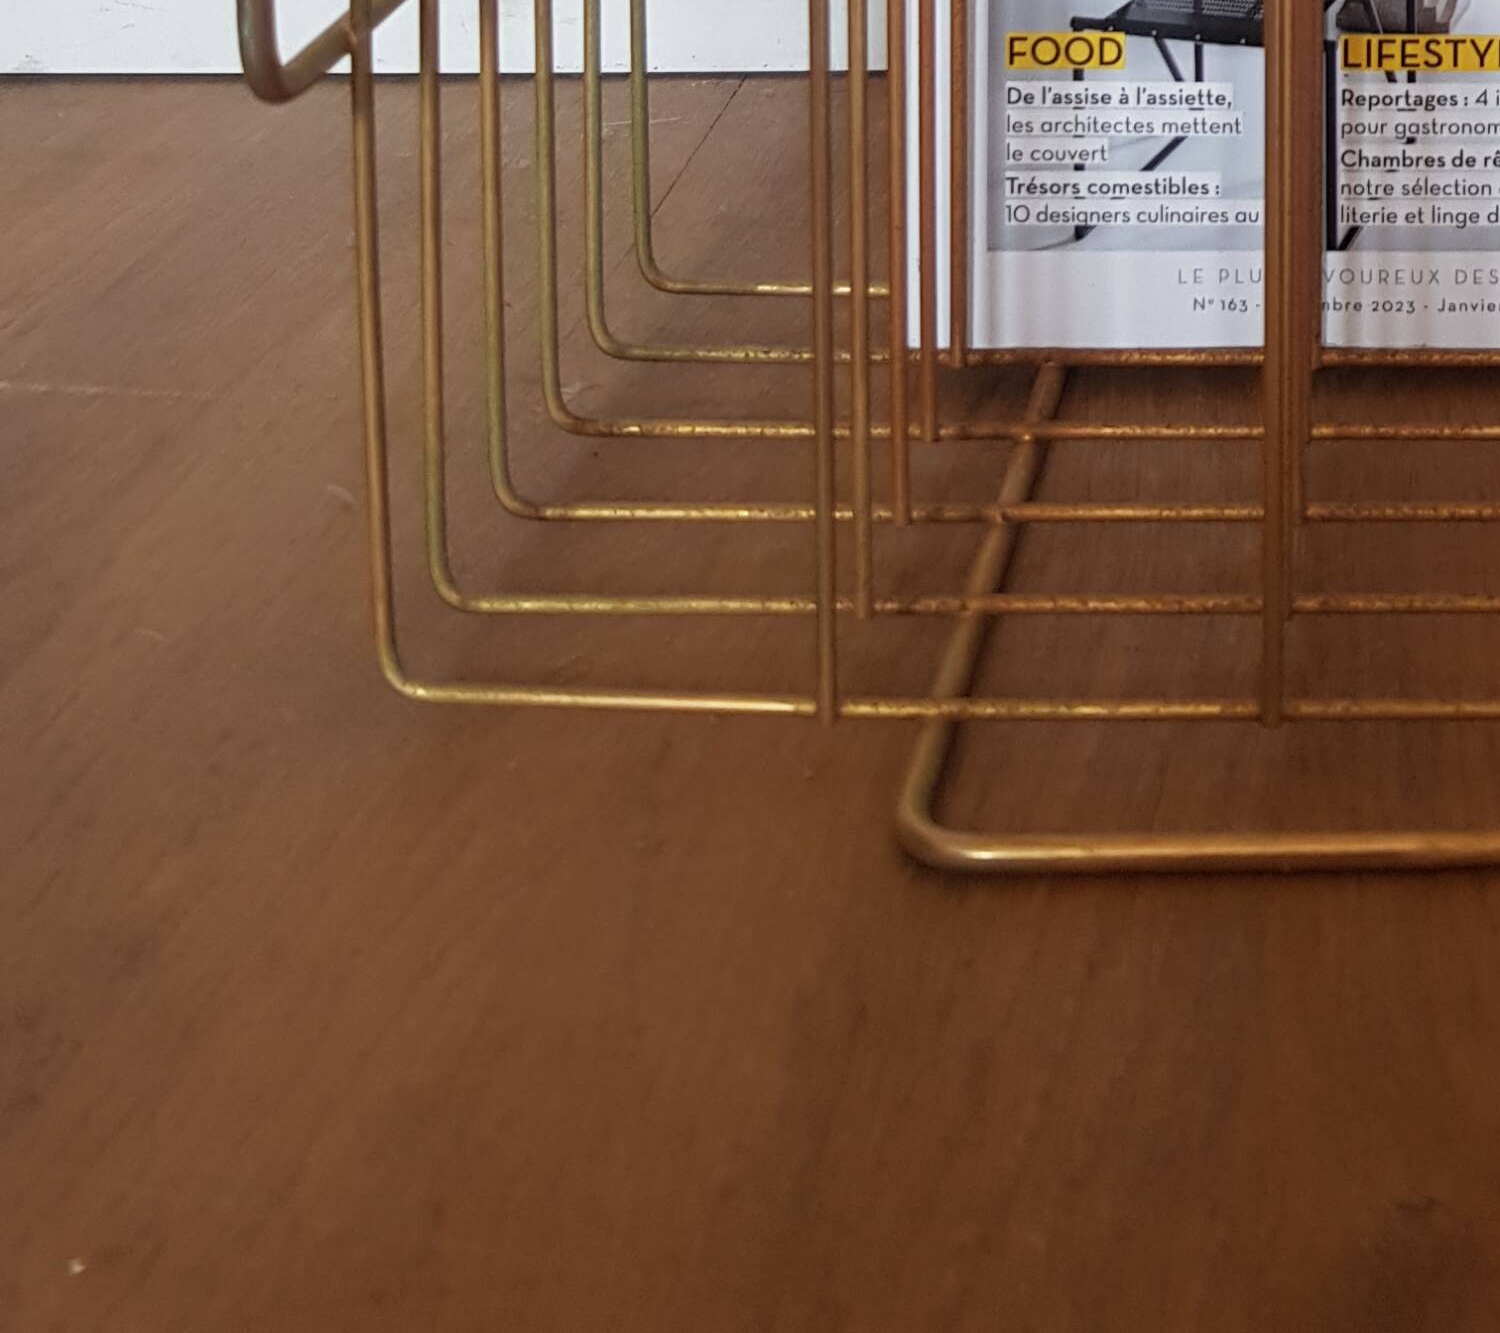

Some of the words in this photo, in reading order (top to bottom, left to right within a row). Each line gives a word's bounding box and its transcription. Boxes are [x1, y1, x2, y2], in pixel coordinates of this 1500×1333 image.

[1009, 36, 1123, 66] FOOD
[1007, 86, 1035, 105] De
[1119, 88, 1130, 105] à
[1341, 89, 1458, 112] Reportages
[1475, 89, 1489, 106] 4
[1007, 113, 1034, 133] les
[1041, 113, 1155, 134] architectes
[1162, 117, 1242, 134] mettent
[1341, 121, 1388, 139] pour
[1006, 143, 1023, 162] le
[1031, 144, 1107, 162] couvert
[1340, 149, 1446, 169] Chambres
[1451, 149, 1476, 169] de
[1005, 176, 1081, 195] Trésors
[1087, 176, 1210, 195] comestibles
[1340, 179, 1394, 196] notre
[1402, 177, 1492, 196] sélection
[1005, 204, 1031, 223] 10
[1036, 204, 1131, 225] designers
[1136, 204, 1229, 224] culinaires
[1235, 211, 1260, 224] au
[1340, 204, 1398, 224] literie
[1405, 206, 1425, 224] et
[1432, 205, 1480, 229] linge
[1178, 268, 1204, 284] LE
[1218, 268, 1262, 284] PLU
[1323, 269, 1440, 285] VOUREUX
[1455, 269, 1499, 285] DES
[1193, 297, 1214, 311] N°
[1220, 298, 1248, 313] 163
[1371, 300, 1416, 314] 2023
